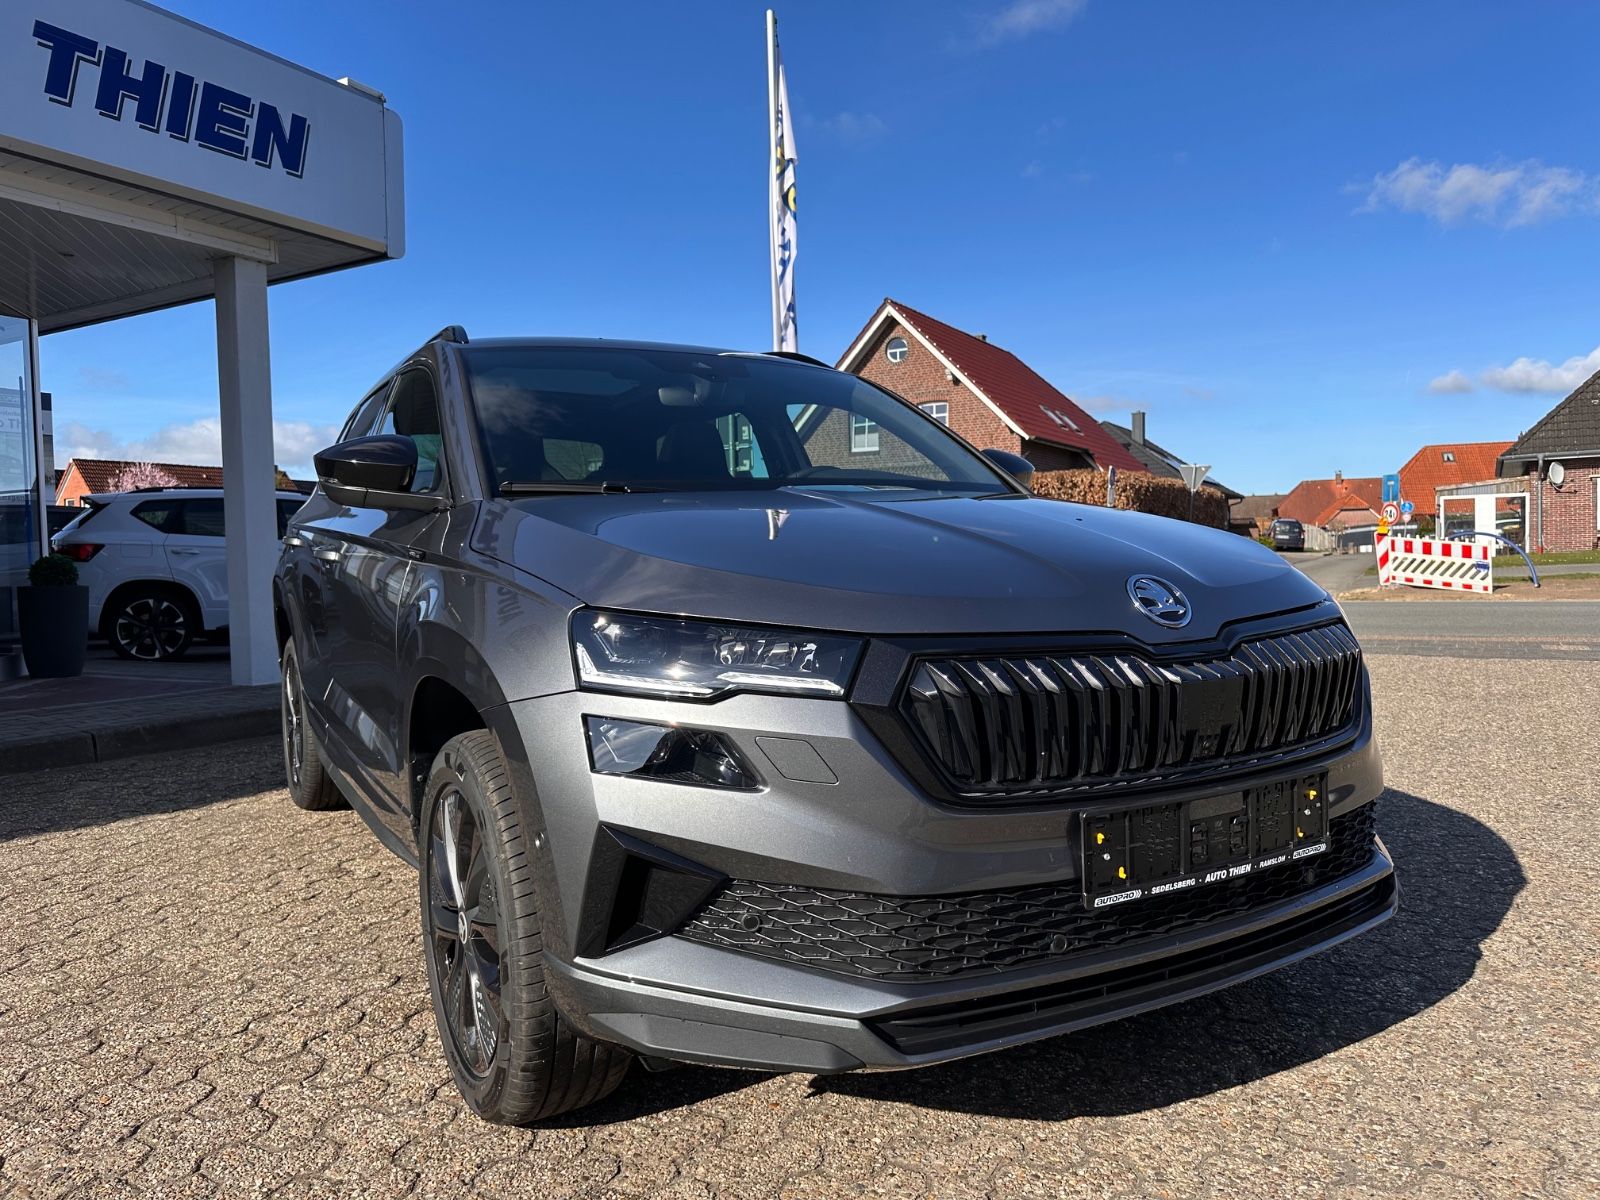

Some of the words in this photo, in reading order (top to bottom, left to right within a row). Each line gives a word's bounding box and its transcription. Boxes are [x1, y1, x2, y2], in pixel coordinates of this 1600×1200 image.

[32, 19, 310, 179] THIEN
[1151, 878, 1196, 895] SEDELSBERG
[1204, 869, 1228, 883] AUTO
[1229, 863, 1252, 877] THIEN
[1259, 855, 1286, 868] RAMSLOH
